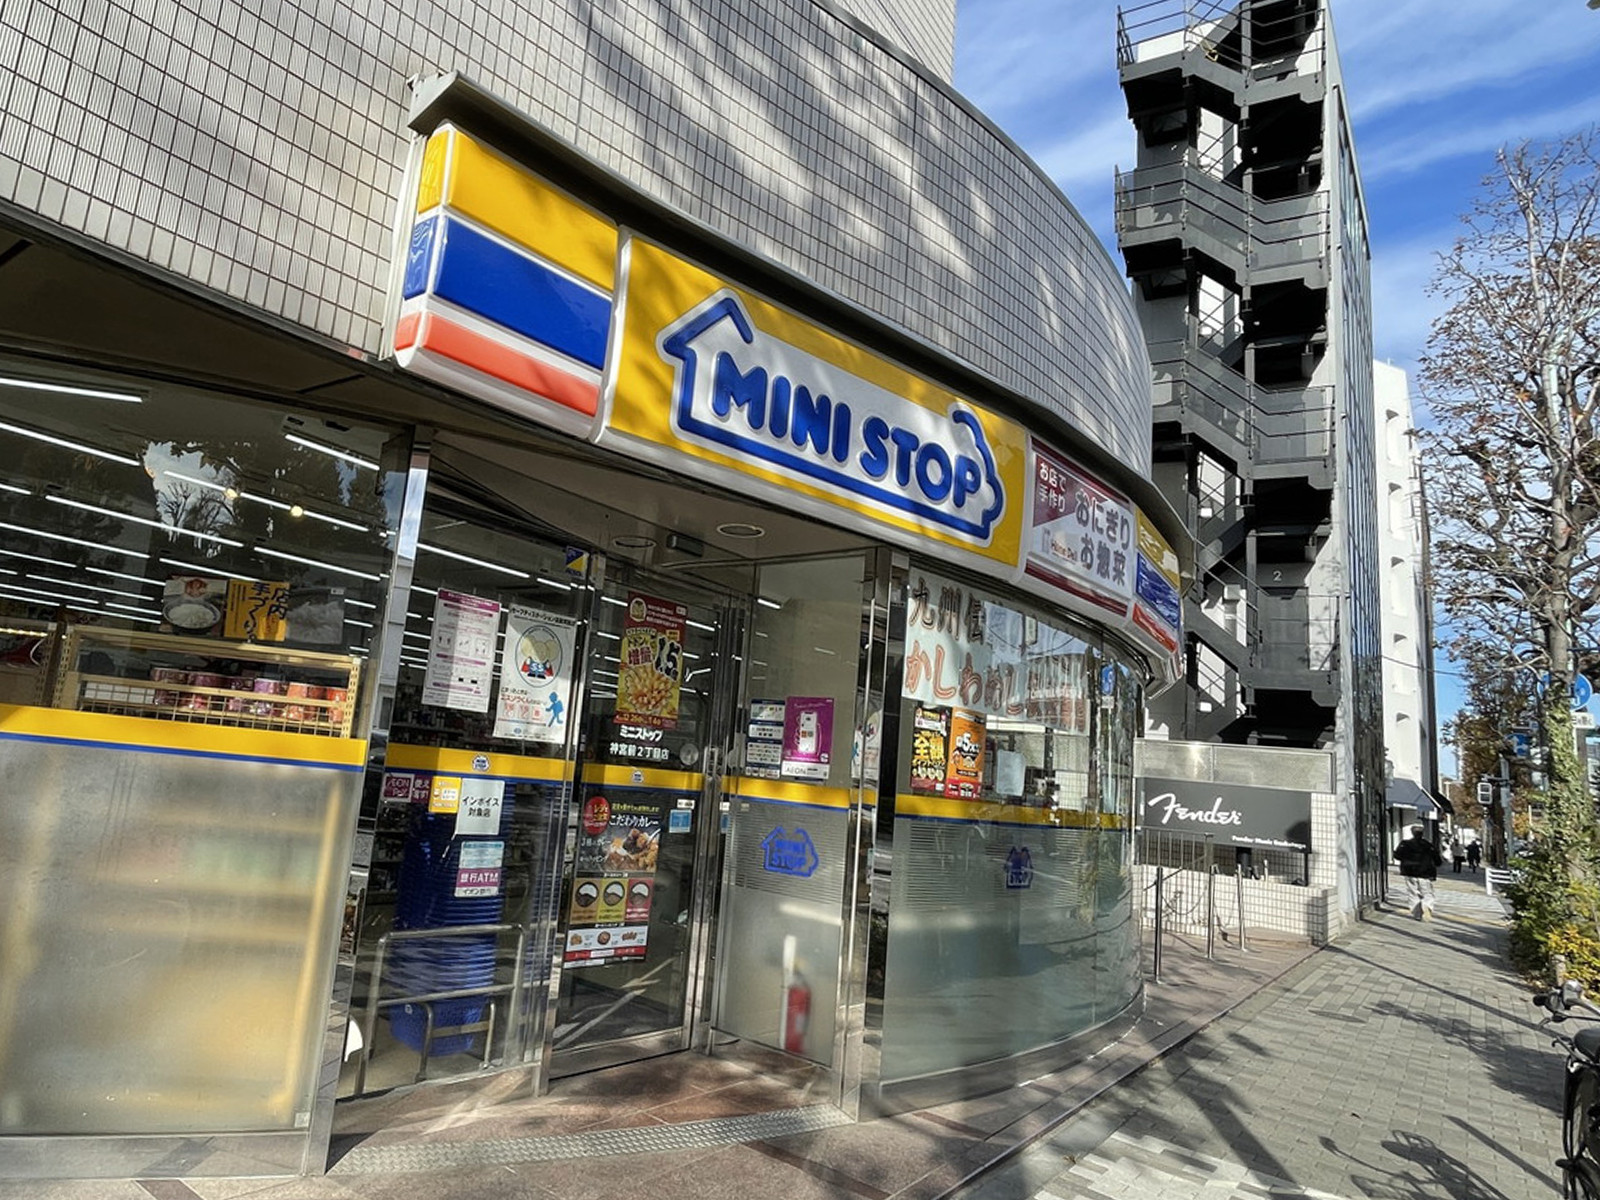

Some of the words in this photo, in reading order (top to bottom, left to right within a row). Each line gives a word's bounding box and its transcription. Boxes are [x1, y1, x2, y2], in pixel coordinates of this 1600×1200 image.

[712, 351, 852, 463] MINI
[860, 416, 981, 509] STOP
[1039, 462, 1067, 492] お店で
[1039, 483, 1066, 513] 手作り
[1075, 488, 1131, 551] おにぎり
[1080, 532, 1126, 587] お惣菜
[1273, 570, 1282, 581] 2
[268, 588, 289, 620] 店内
[620, 724, 663, 742] ミニストップ
[609, 742, 670, 760] 神宮前2丁目店
[462, 796, 500, 808] インボイス
[468, 807, 491, 818] 対象店
[1148, 793, 1242, 825] Fender
[609, 814, 660, 828] こだわりカレー
[460, 872, 499, 884] 銀行ATM
